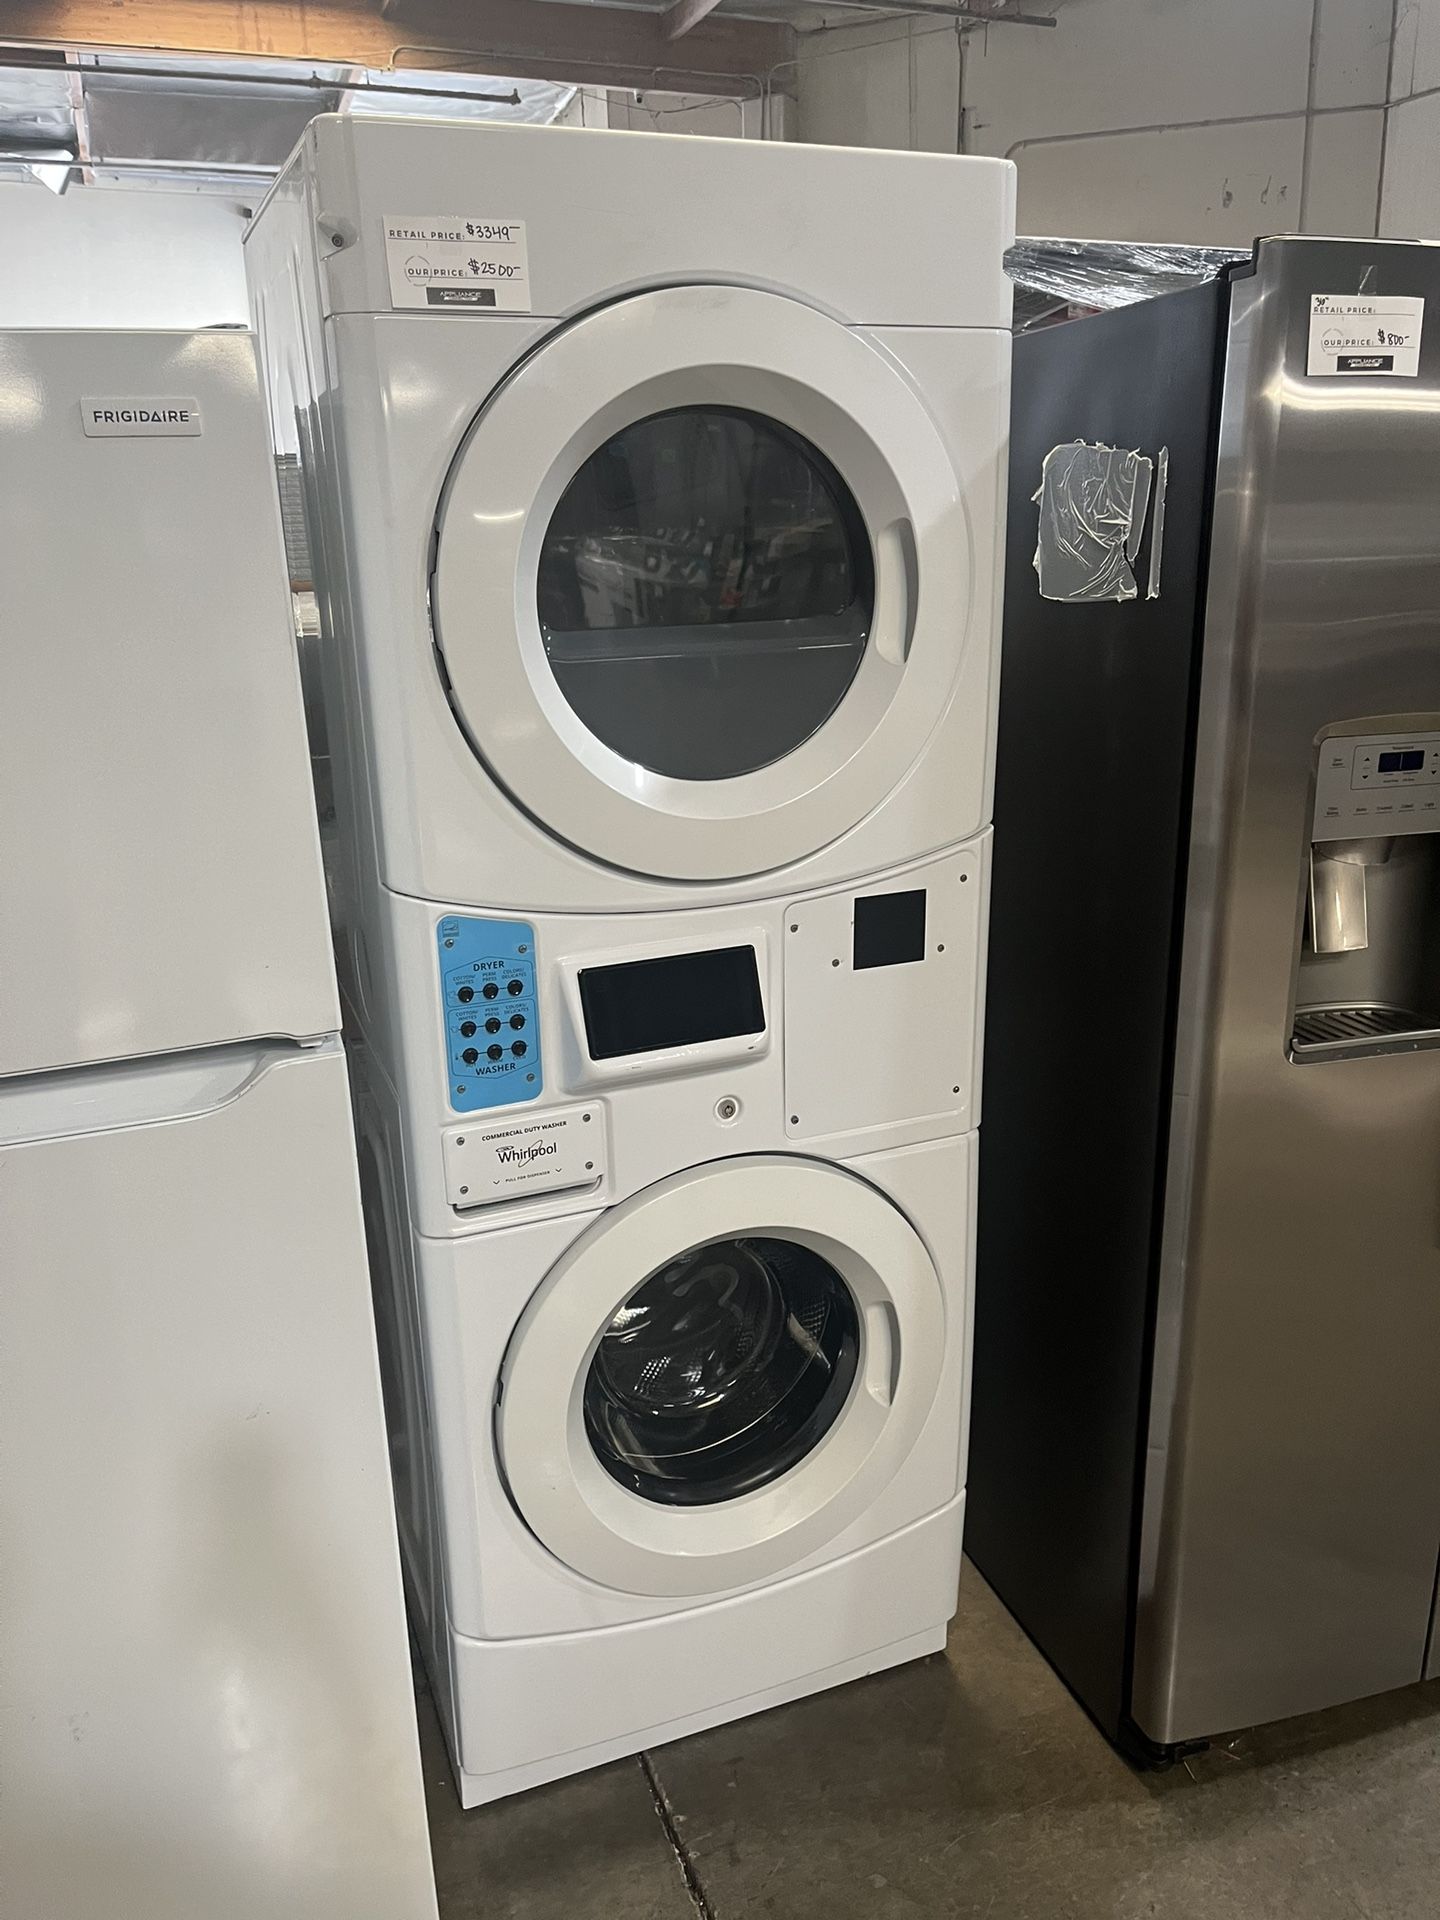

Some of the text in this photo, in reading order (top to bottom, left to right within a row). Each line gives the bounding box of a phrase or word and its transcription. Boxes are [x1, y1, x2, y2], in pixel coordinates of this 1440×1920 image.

[389, 229, 427, 239] RETAIL
[430, 232, 465, 241] PRICE:
[407, 268, 429, 276] OUR
[433, 268, 468, 277] PRICE:
[93, 410, 190, 423] FRIGIDAIRE
[473, 960, 505, 972] DRYER
[475, 1063, 517, 1076] WASHER
[481, 1120, 567, 1141] COMMERCIAL DUTY WASHER
[498, 1142, 557, 1163] Whirlpool
[527, 1170, 551, 1178] DISPENSER
